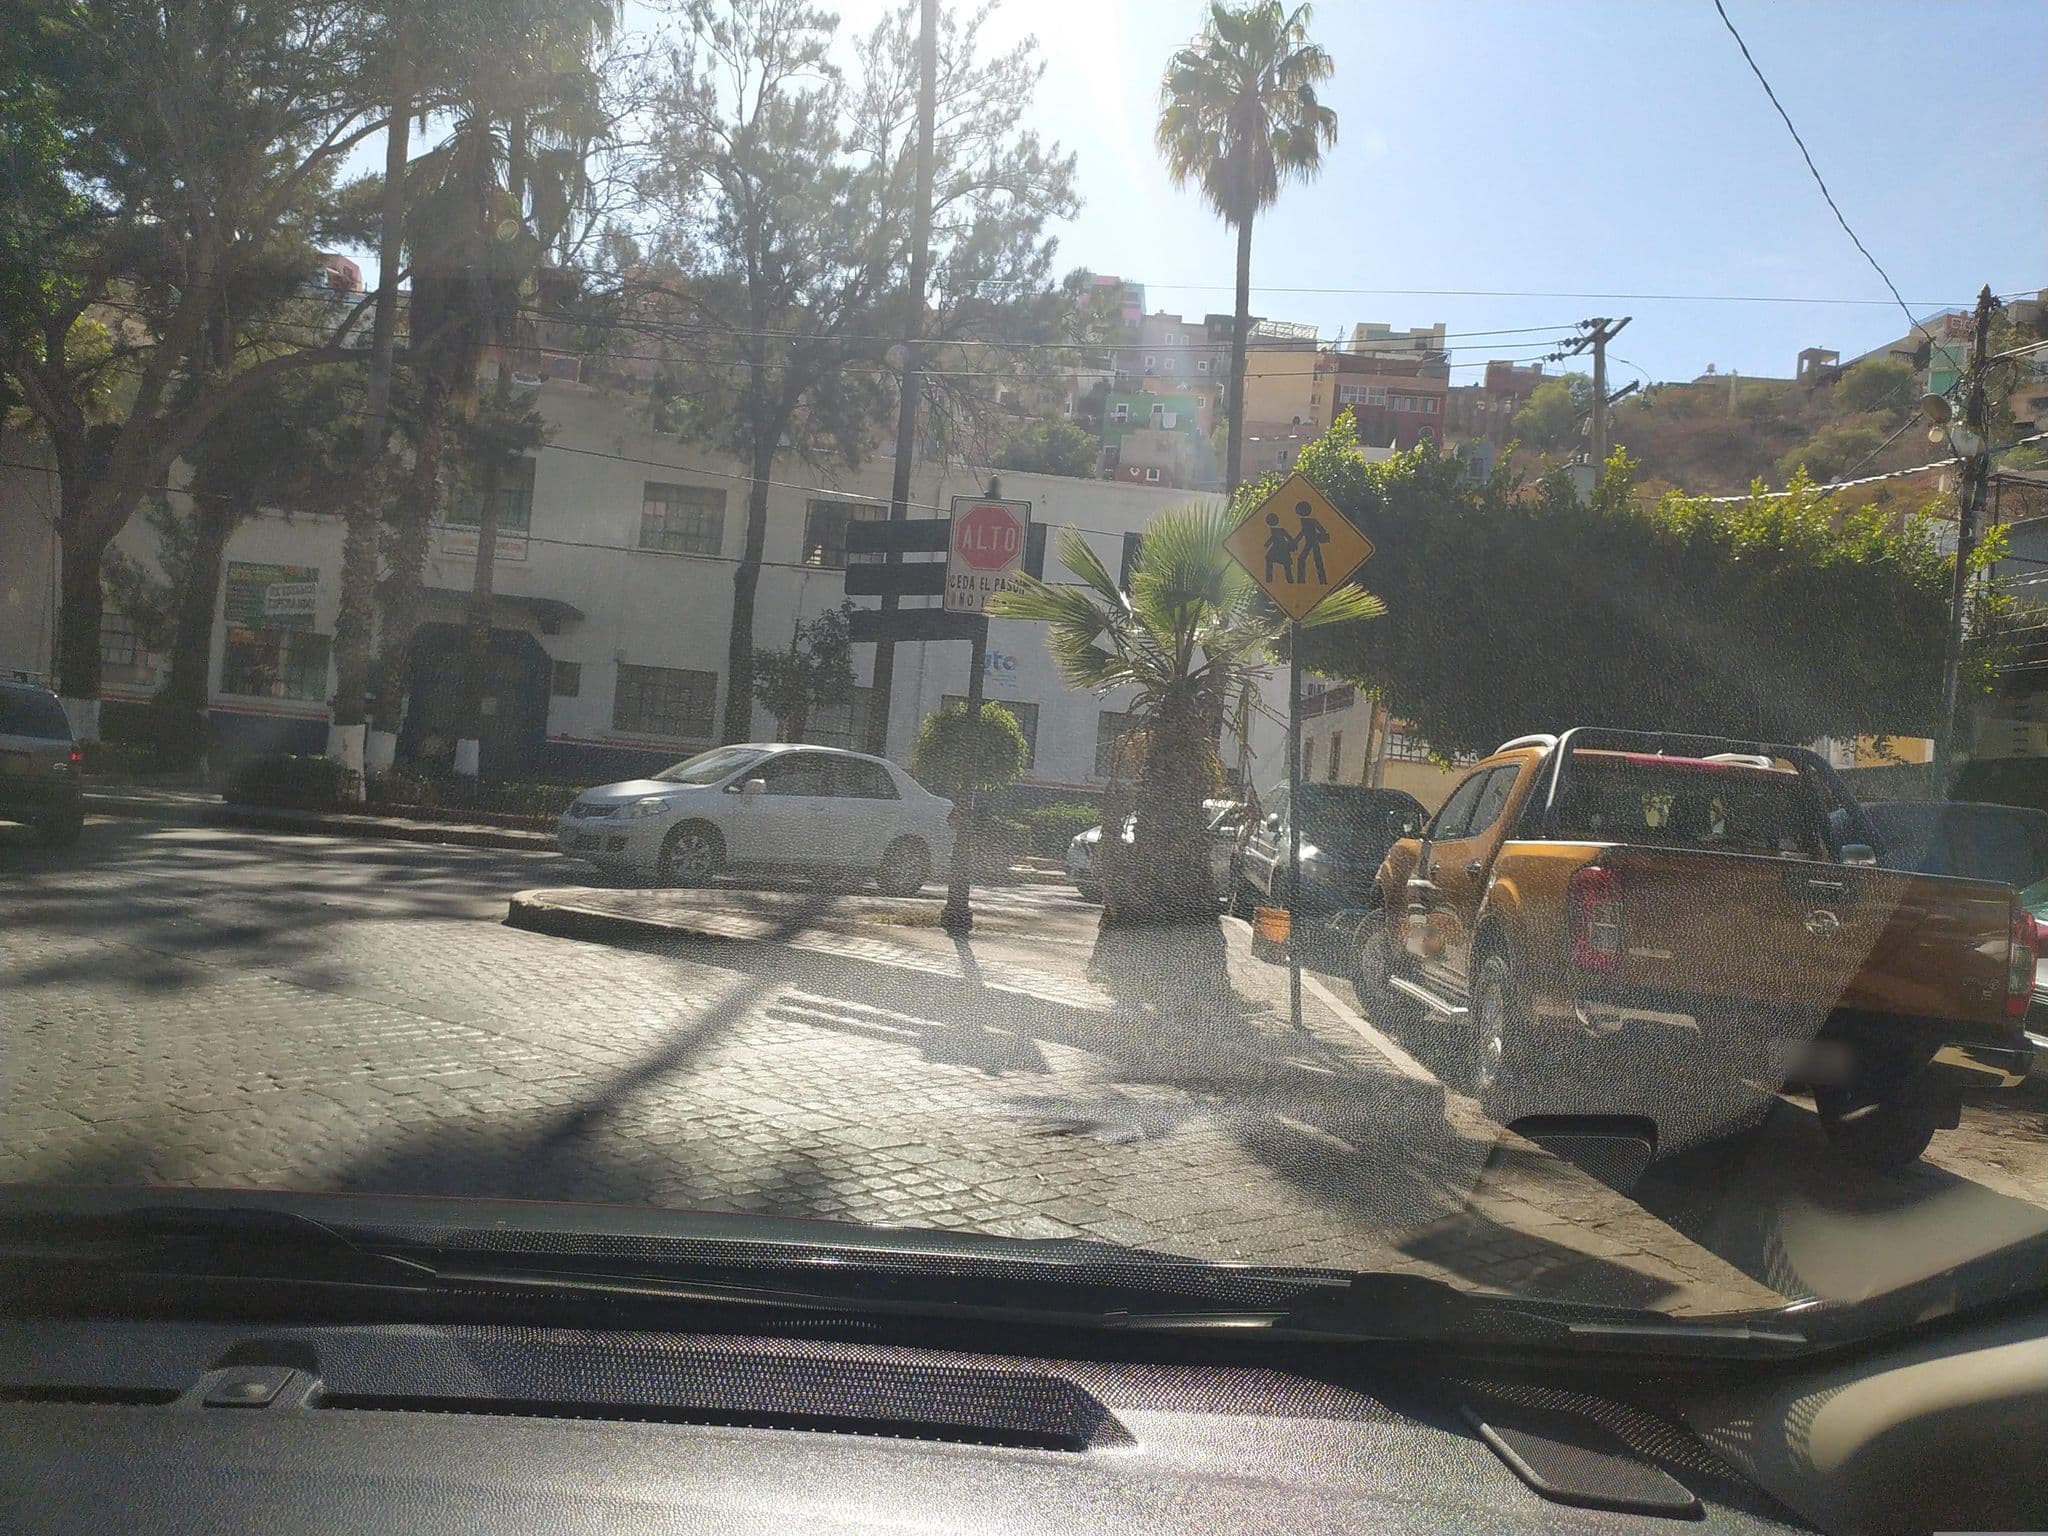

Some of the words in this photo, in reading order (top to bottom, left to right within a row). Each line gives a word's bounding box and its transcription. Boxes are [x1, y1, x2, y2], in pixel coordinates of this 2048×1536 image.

[962, 526, 1016, 551] ALTO
[950, 574, 975, 590] CEDA
[980, 576, 991, 591] EL
